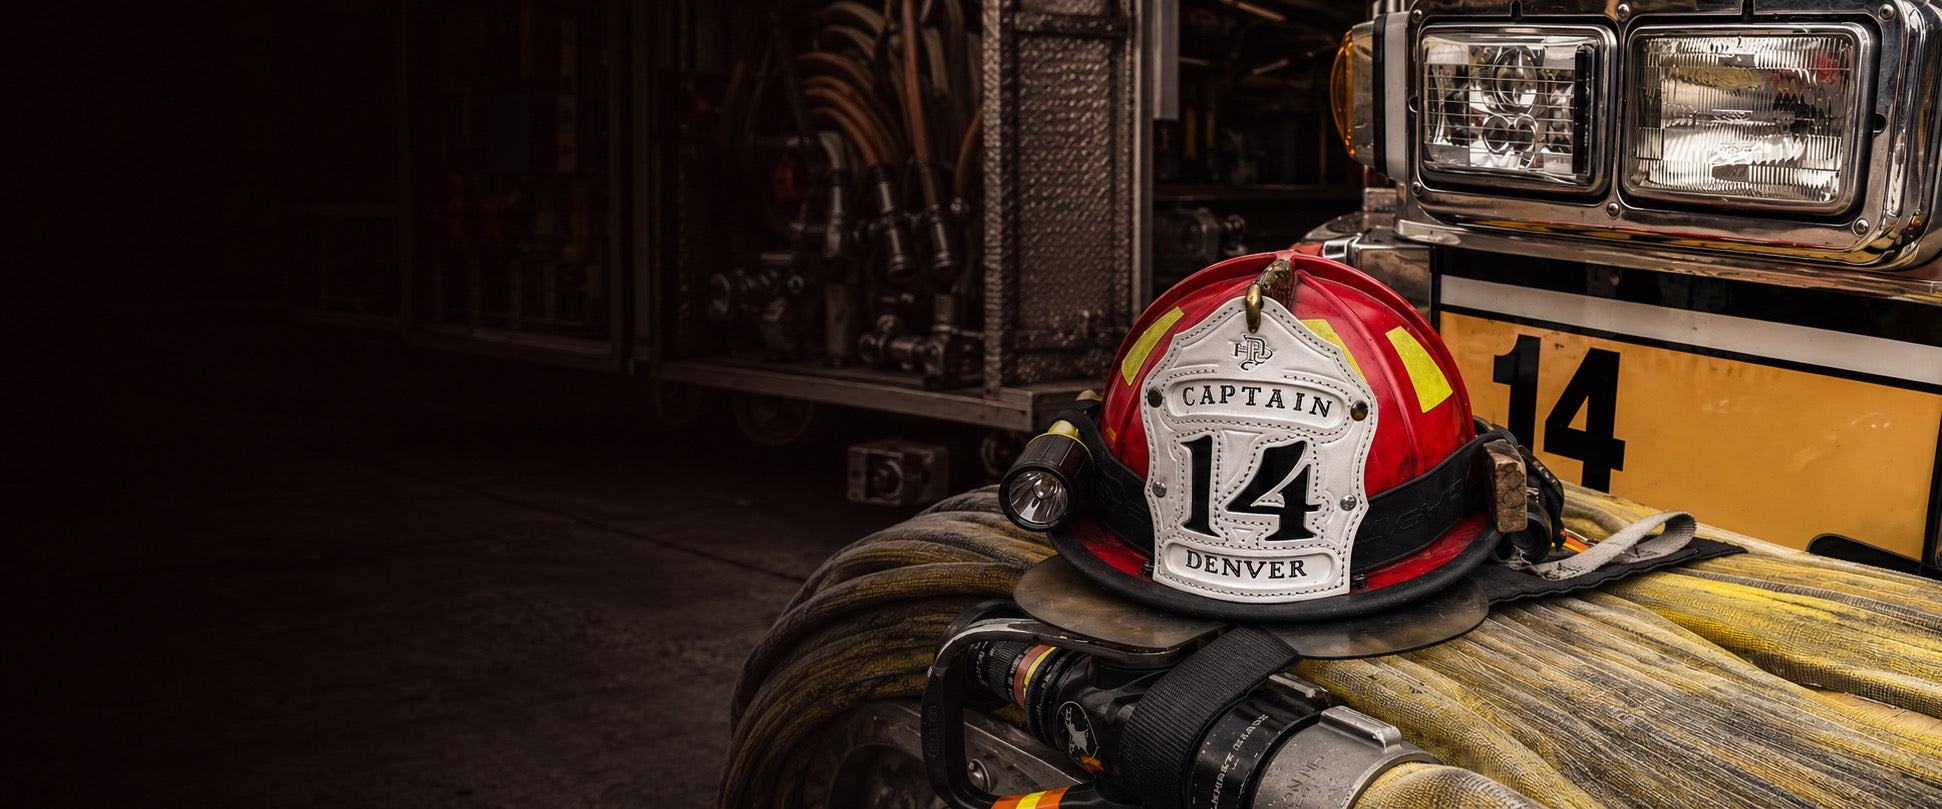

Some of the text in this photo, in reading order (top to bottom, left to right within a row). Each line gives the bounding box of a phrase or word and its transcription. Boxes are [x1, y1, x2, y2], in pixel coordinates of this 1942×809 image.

[1182, 384, 1333, 418] CAPTAIN
[1493, 334, 1626, 494] 14
[1179, 434, 1321, 541] 14
[1185, 550, 1308, 579] DENVER
